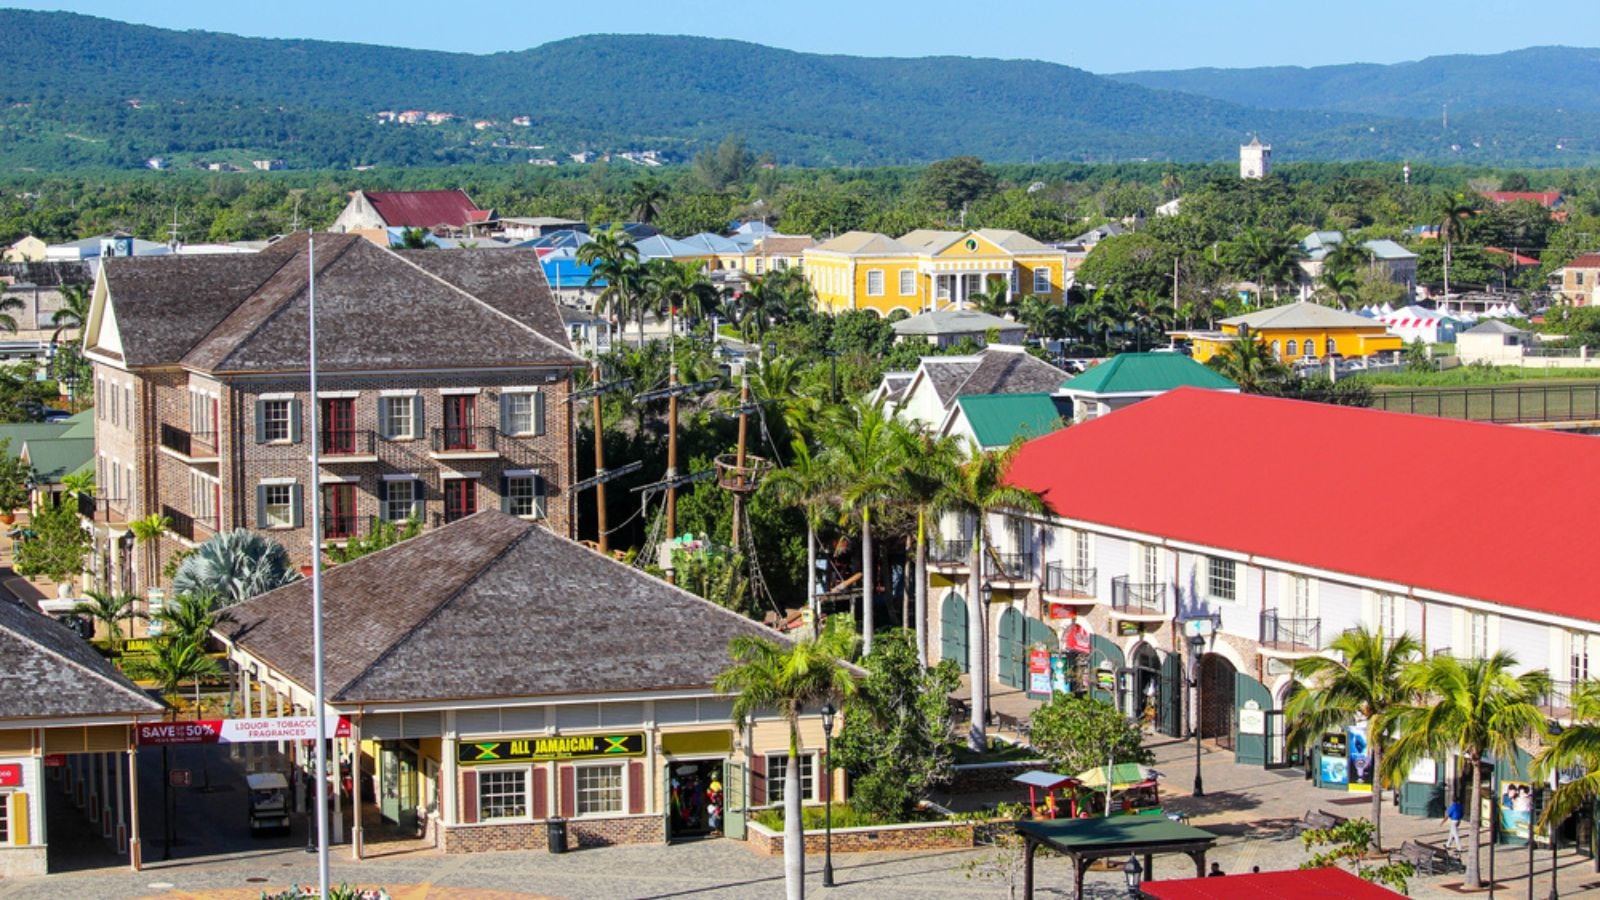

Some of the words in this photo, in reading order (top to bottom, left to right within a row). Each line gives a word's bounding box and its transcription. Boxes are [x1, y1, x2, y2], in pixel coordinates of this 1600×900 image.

[142, 726, 175, 738] SAVE
[186, 724, 215, 736] 50%
[235, 722, 269, 730] LIQUOR
[249, 729, 306, 737] FRAGRANCES
[510, 740, 530, 755] ALL
[535, 736, 594, 754] JAMAICAN
